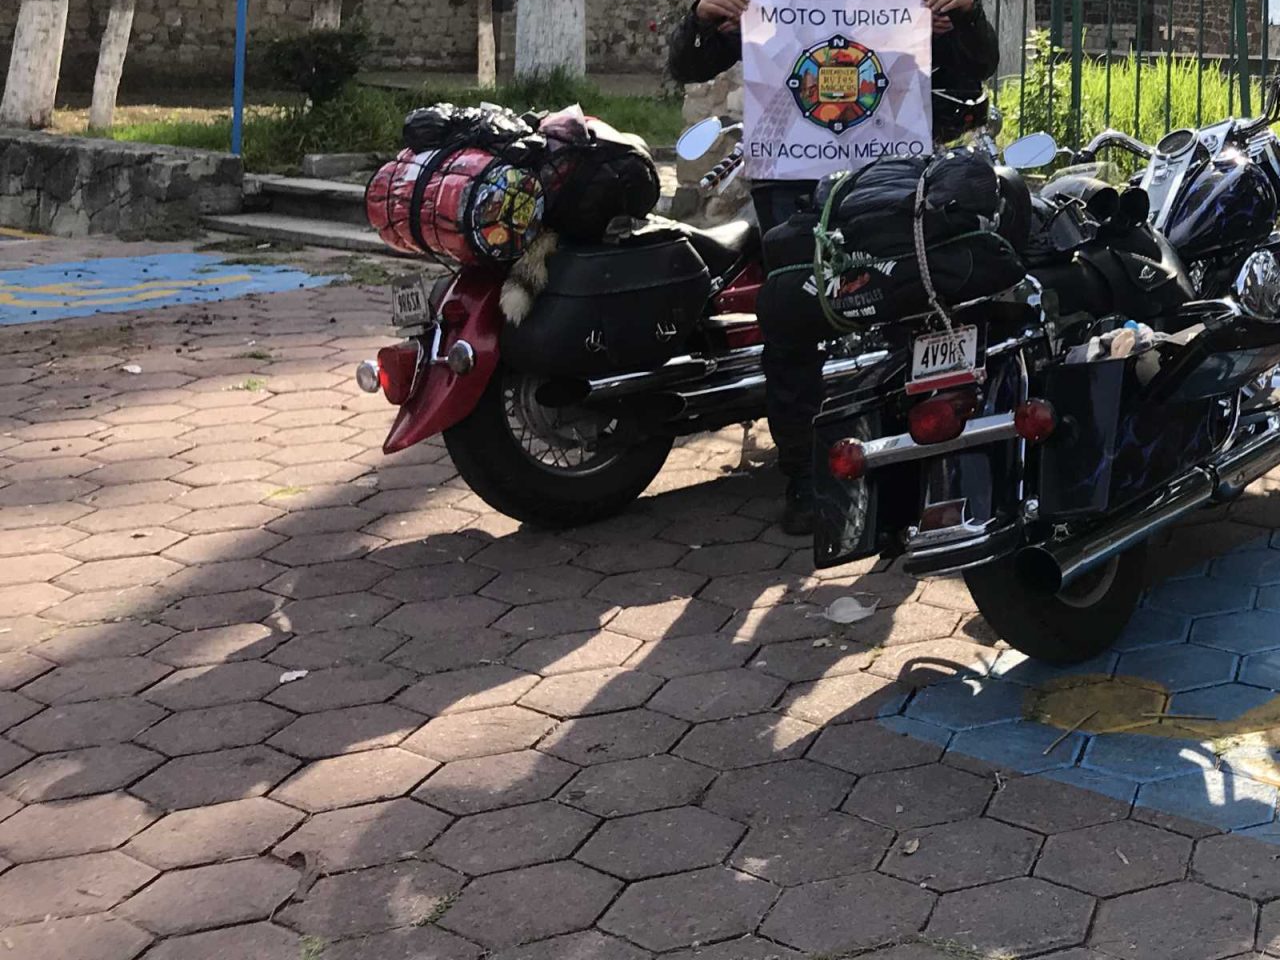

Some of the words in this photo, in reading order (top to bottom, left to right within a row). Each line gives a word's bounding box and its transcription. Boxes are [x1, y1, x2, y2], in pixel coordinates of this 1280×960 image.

[761, 6, 826, 26] MOTO
[832, 7, 912, 27] TURISTA
[751, 142, 773, 158] EN
[777, 141, 849, 159] ACCIÓN
[855, 139, 924, 158] MÉXICO
